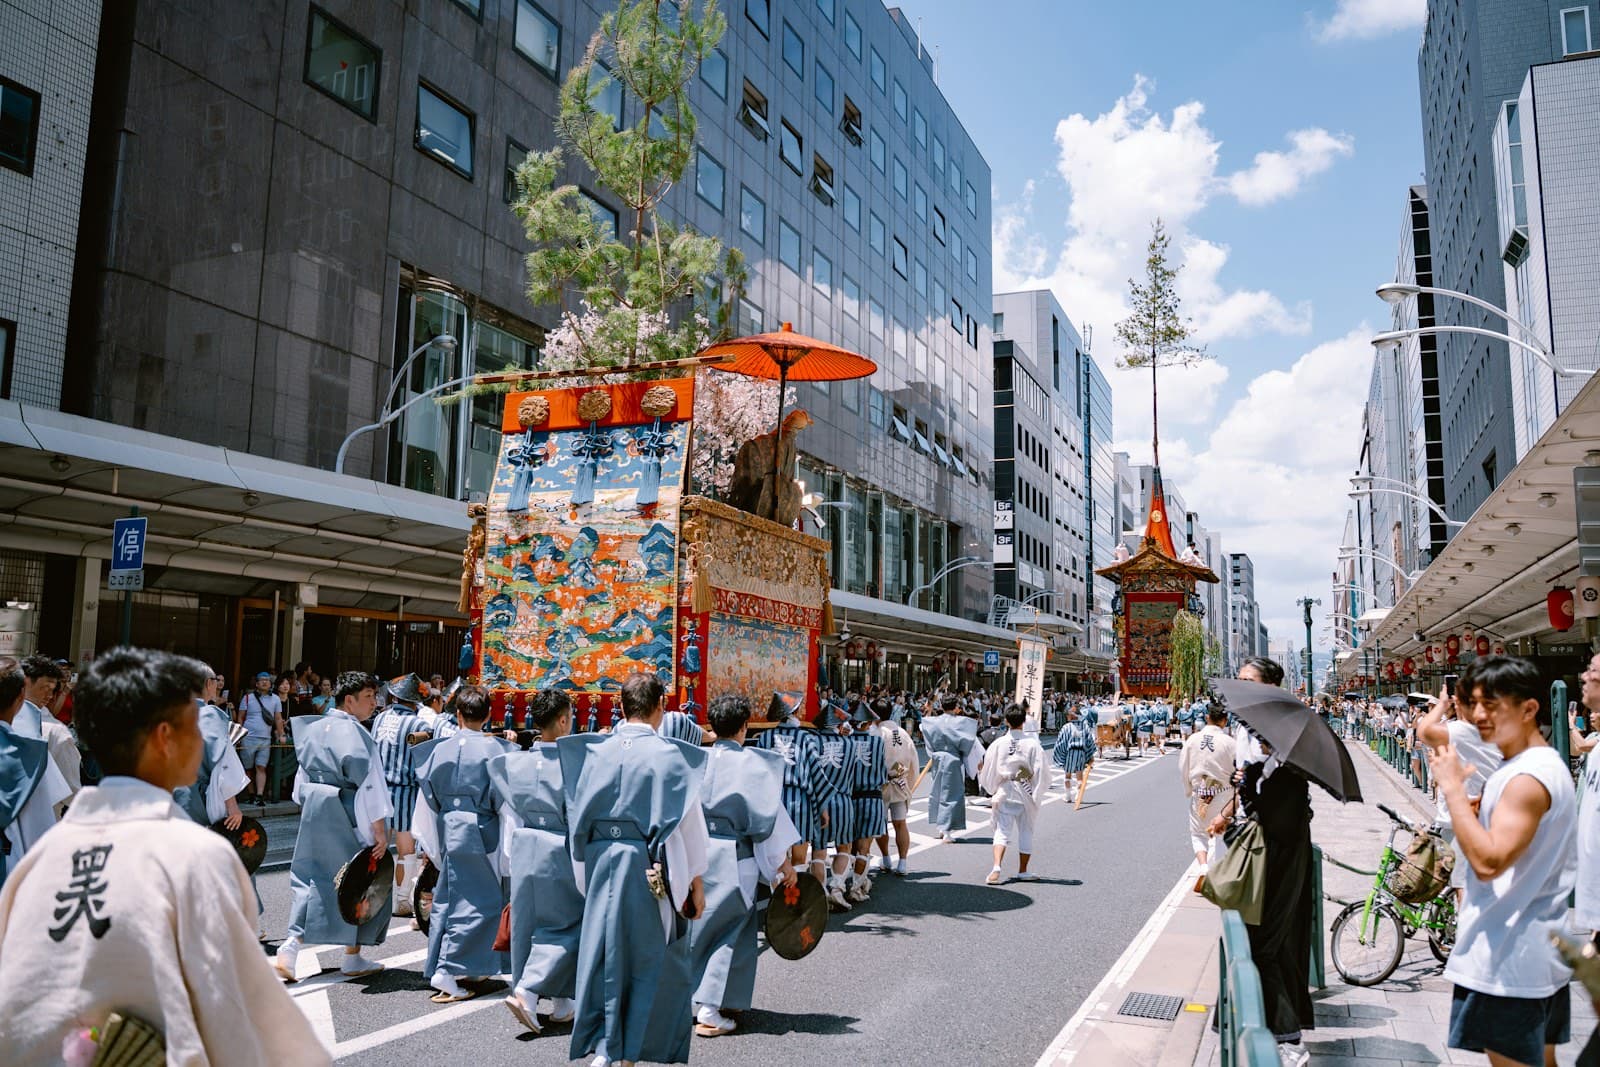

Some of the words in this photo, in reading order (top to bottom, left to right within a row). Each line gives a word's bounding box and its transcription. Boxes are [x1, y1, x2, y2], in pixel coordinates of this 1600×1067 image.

[118, 528, 140, 561] 停
[998, 535, 1012, 544] 3F
[110, 575, 141, 585] ここから
